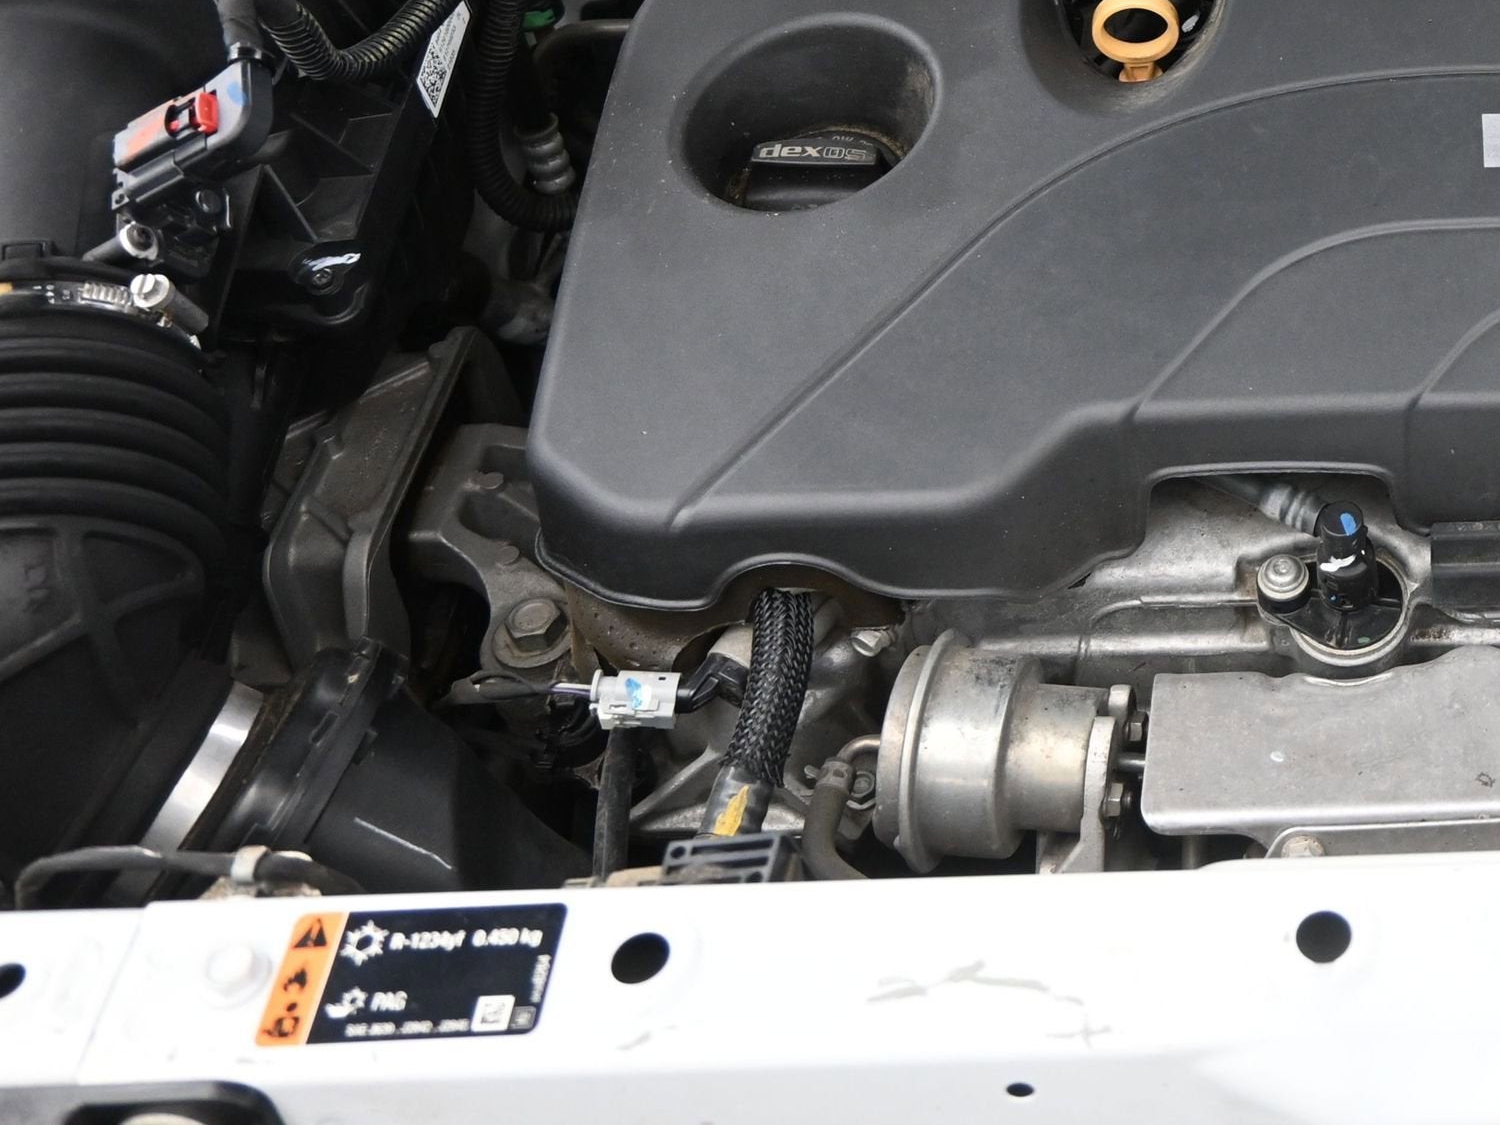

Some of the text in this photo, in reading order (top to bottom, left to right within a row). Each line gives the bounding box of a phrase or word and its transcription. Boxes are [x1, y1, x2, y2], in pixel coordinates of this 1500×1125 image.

[758, 143, 867, 161] dexos
[519, 928, 545, 949] kg
[370, 990, 409, 1013] PAG
